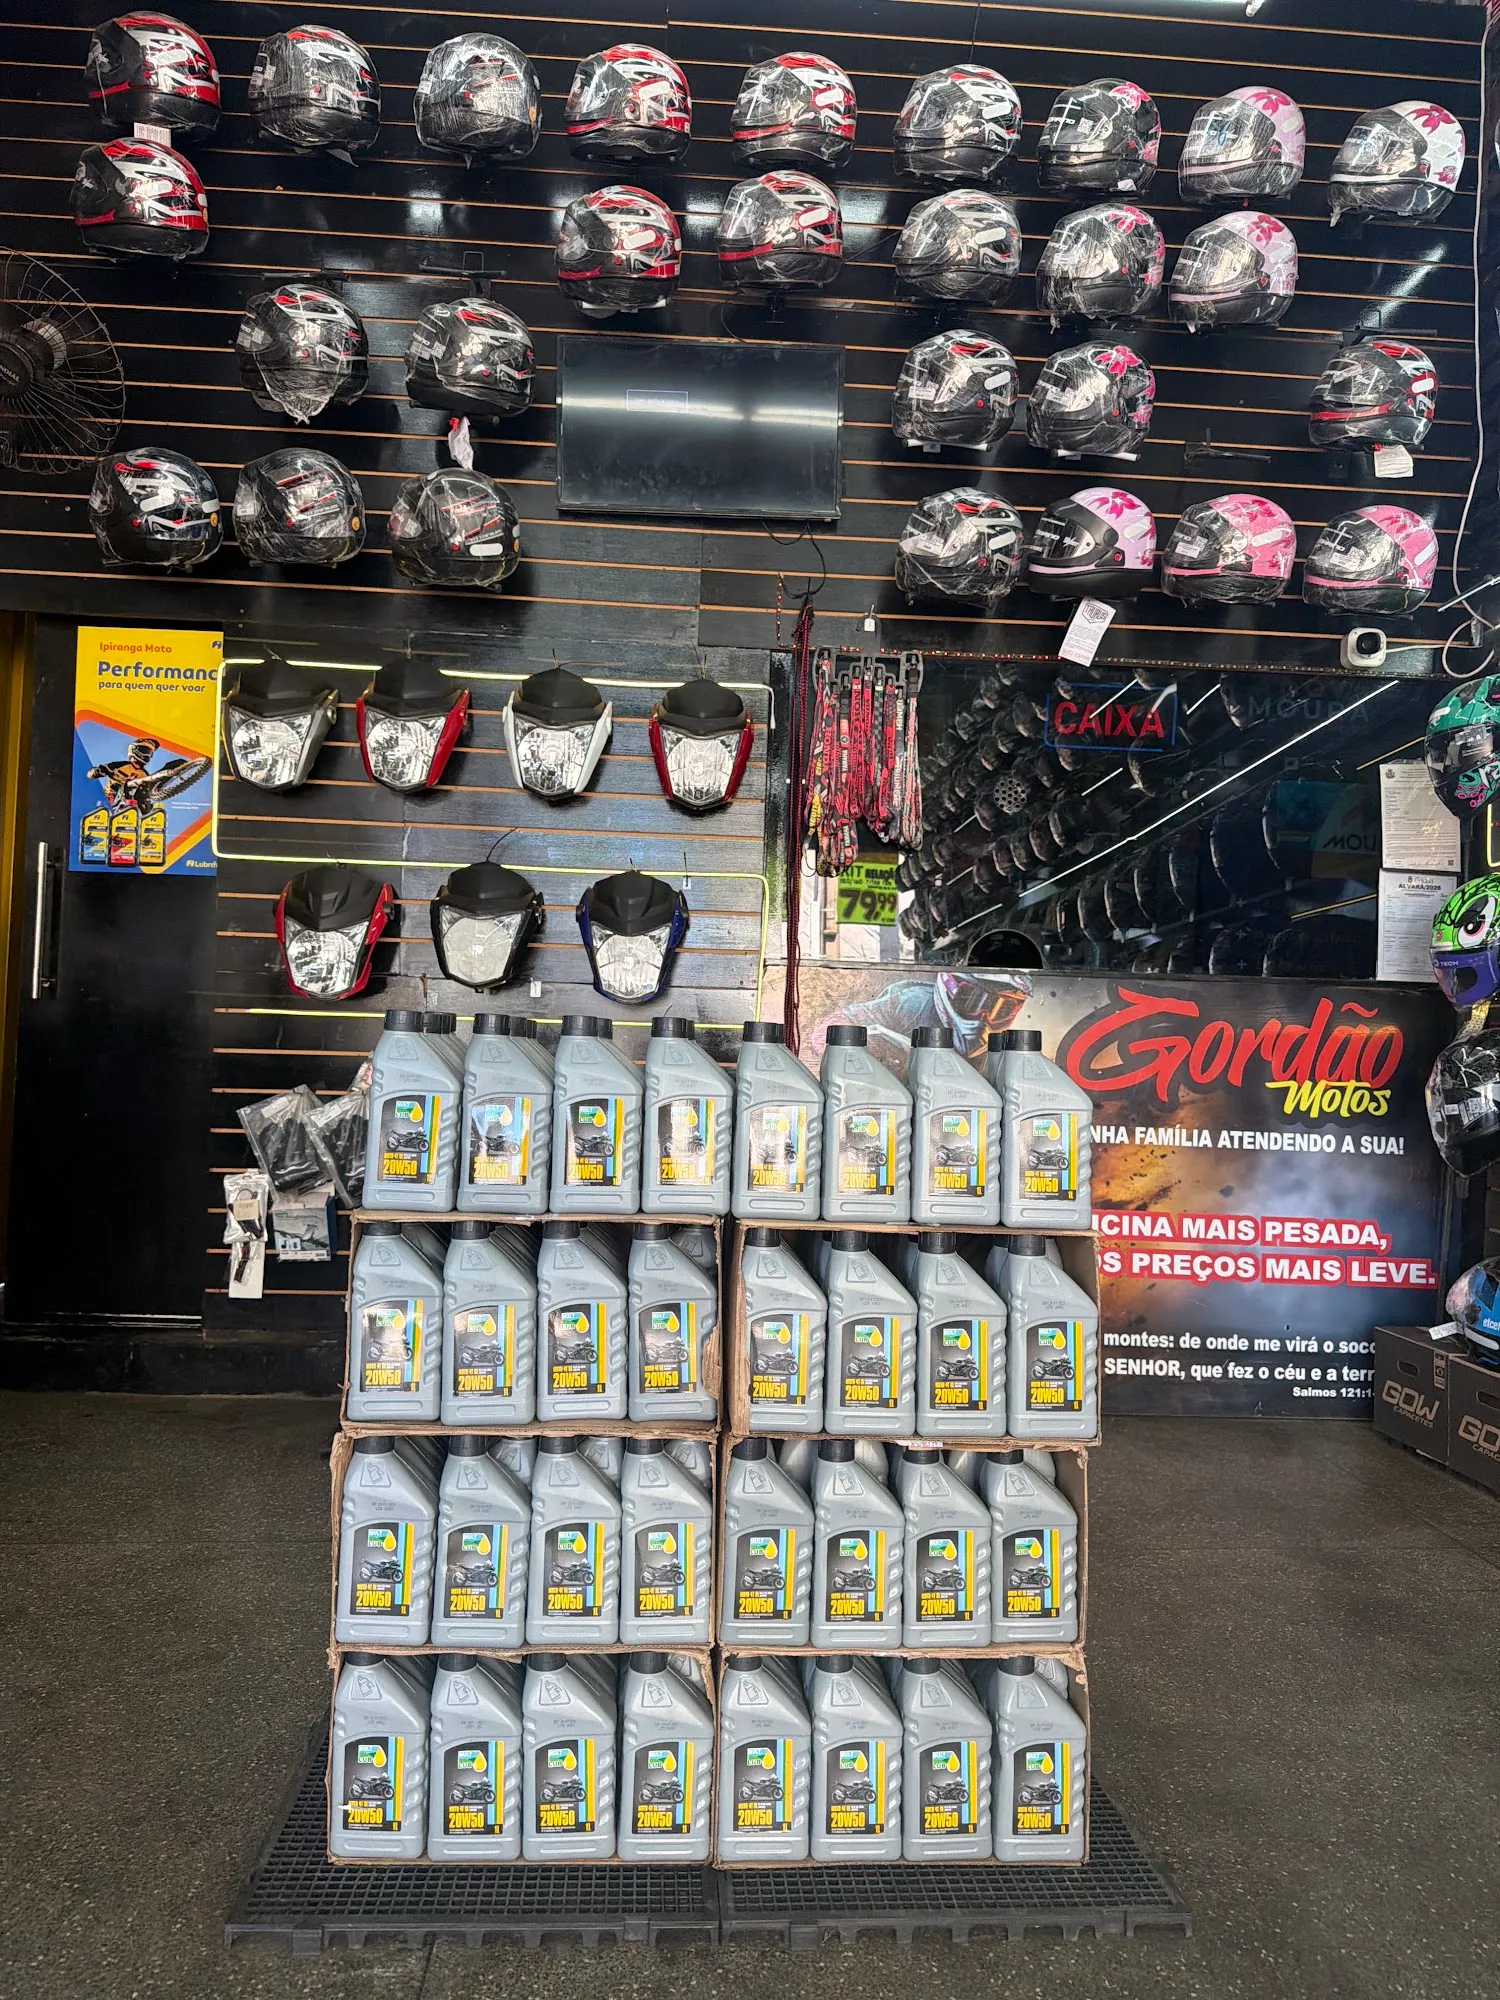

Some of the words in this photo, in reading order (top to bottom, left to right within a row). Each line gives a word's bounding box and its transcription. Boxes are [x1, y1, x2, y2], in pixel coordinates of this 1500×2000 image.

[1084, 603, 1109, 621] TAURUS
[99, 642, 142, 653] Ipiranga
[145, 644, 172, 653] Moto
[98, 681, 122, 690] para
[124, 682, 153, 691] quem
[155, 683, 179, 692] quer
[182, 684, 205, 692] voar
[1054, 701, 1165, 738] CAIXA
[822, 727, 832, 772] HONDA
[841, 749, 849, 772] YAMAHA
[843, 824, 851, 847] YAMAHA
[1066, 986, 1404, 1102] Gordão
[1265, 1079, 1392, 1118] Motos
[1135, 1124, 1212, 1148] FAMÍLIA
[1217, 1131, 1336, 1153] ATENDENDO
[1340, 1135, 1356, 1153] A
[1360, 1136, 1404, 1155] SUA!
[382, 1159, 417, 1176] 20W50
[843, 1173, 877, 1189] 20W50
[934, 1173, 968, 1188] 20W50
[1025, 1177, 1059, 1193] 20W50
[1182, 1218, 1255, 1241] MAIS
[1265, 1221, 1387, 1250] PESADA,
[1098, 1252, 1122, 1273] S
[1132, 1253, 1256, 1281] PREÇOS
[1266, 1258, 1341, 1281] MAIS
[1351, 1261, 1436, 1284] LEVE.
[1103, 1331, 1174, 1348] montes:
[1179, 1332, 1201, 1349] de
[1206, 1334, 1249, 1350] onde
[1253, 1338, 1280, 1351] me
[1285, 1336, 1318, 1353] virá
[1322, 1340, 1334, 1353] o
[365, 1369, 401, 1385] 20W50
[1104, 1358, 1186, 1380] SENHOR,
[1190, 1364, 1223, 1381] que
[1227, 1362, 1254, 1379] fez
[1258, 1366, 1269, 1379] o
[1273, 1363, 1306, 1380] céu
[1310, 1367, 1322, 1380] e
[1326, 1368, 1337, 1381] a
[458, 1374, 493, 1391] 20W50
[552, 1372, 588, 1388] 20W50
[644, 1371, 679, 1387] 20W50
[753, 1382, 787, 1398] 20W50
[845, 1385, 879, 1401] 20W50
[934, 1388, 969, 1404] 20W50
[1030, 1388, 1064, 1404] 20W50
[1292, 1387, 1337, 1397] Salmos
[1382, 1379, 1440, 1420] GOW
[1393, 1406, 1434, 1428] CAPACETES
[356, 1591, 392, 1607] 20W50
[450, 1595, 486, 1611] 20W50
[548, 1594, 583, 1610] 20W50
[639, 1594, 675, 1610] 20W50
[739, 1597, 774, 1613] 20W50
[830, 1599, 865, 1615] 20W50
[921, 1599, 955, 1615] 20W50
[1007, 1596, 1041, 1612] 20W50
[348, 1808, 383, 1824] 20W50
[449, 1812, 484, 1828] 20W50
[540, 1811, 575, 1827] 20W50
[637, 1811, 673, 1828] 20W50
[738, 1809, 773, 1825] 20W50
[830, 1812, 866, 1828] 20W50
[924, 1812, 959, 1828] 20W50
[1017, 1812, 1051, 1829] 20W50
